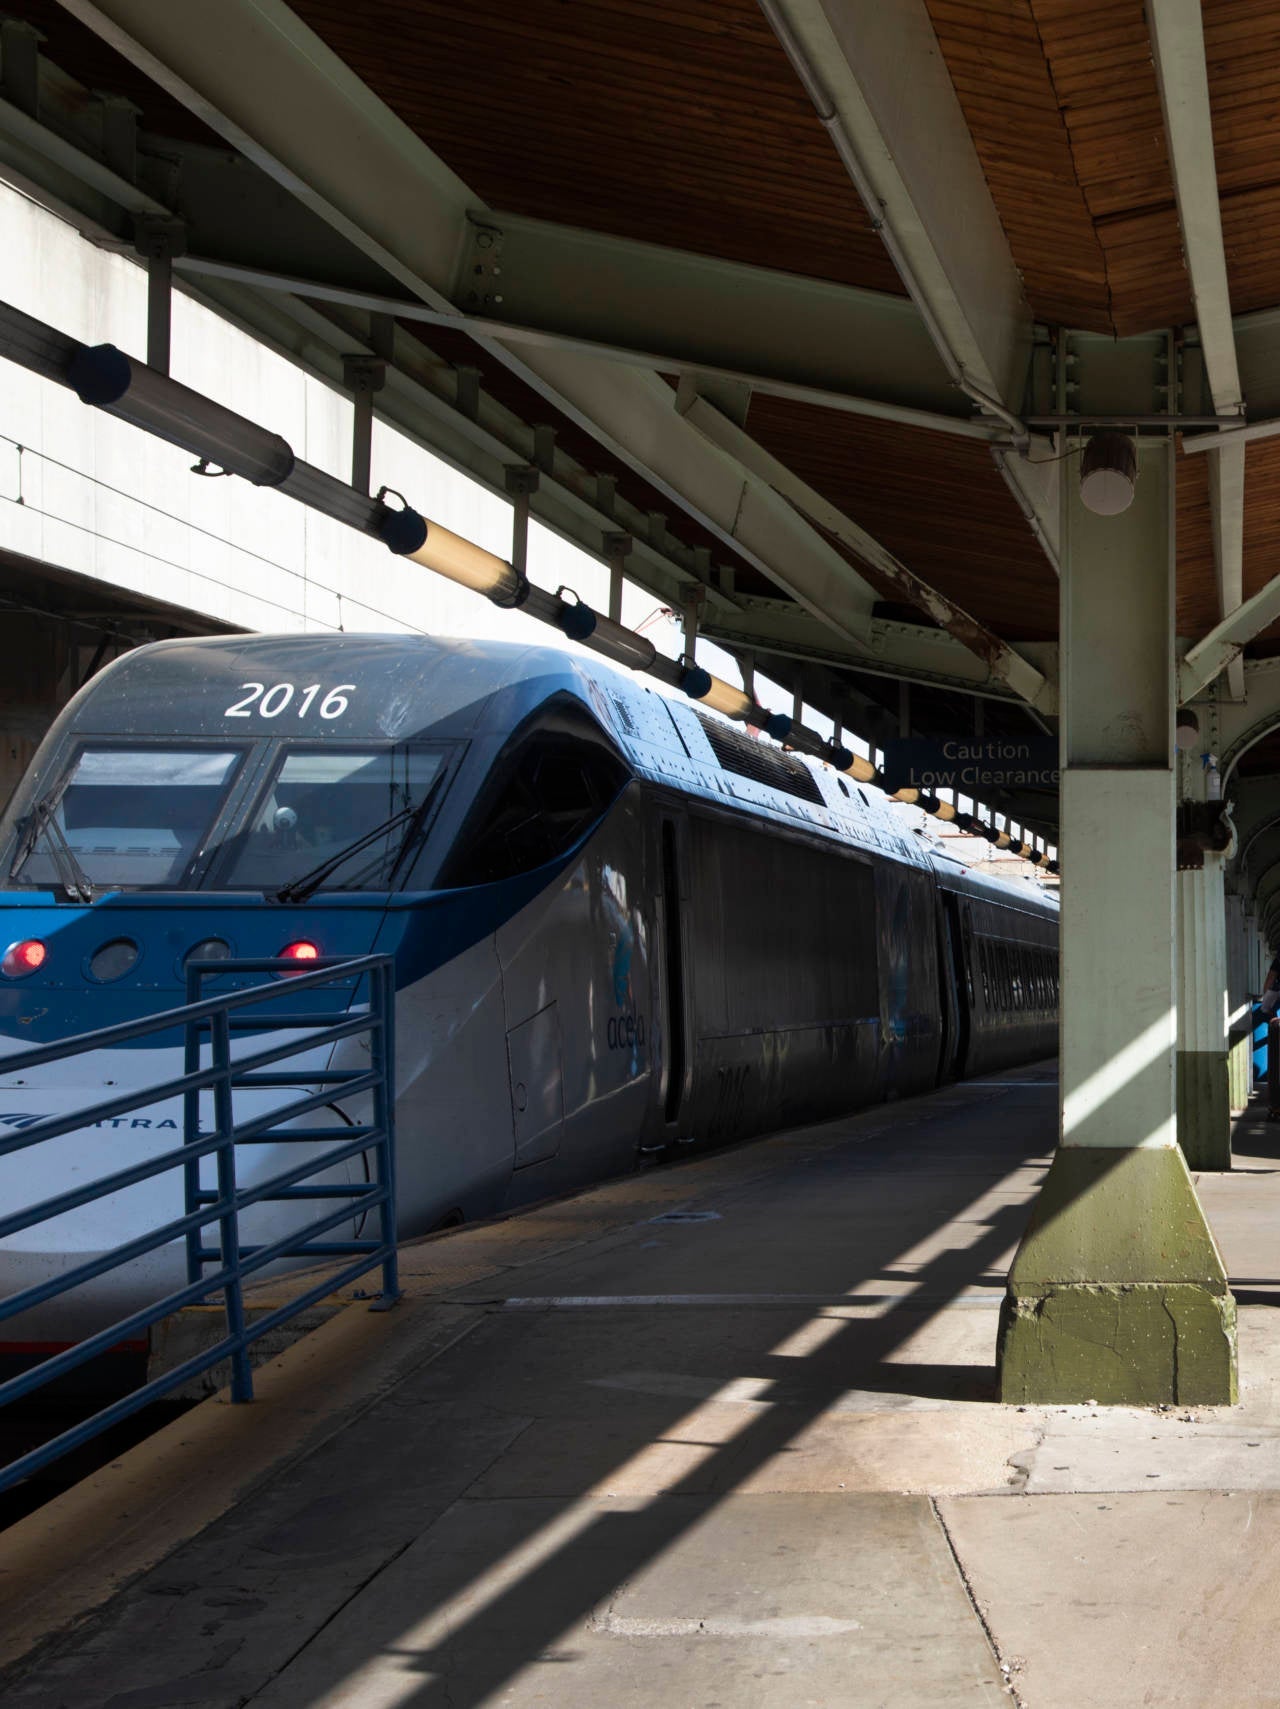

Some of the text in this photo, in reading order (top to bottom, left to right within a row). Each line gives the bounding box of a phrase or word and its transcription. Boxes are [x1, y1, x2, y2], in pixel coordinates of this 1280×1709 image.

[224, 682, 357, 720] 2016
[943, 741, 1030, 760] Caution
[909, 766, 1061, 785] Low Clearance
